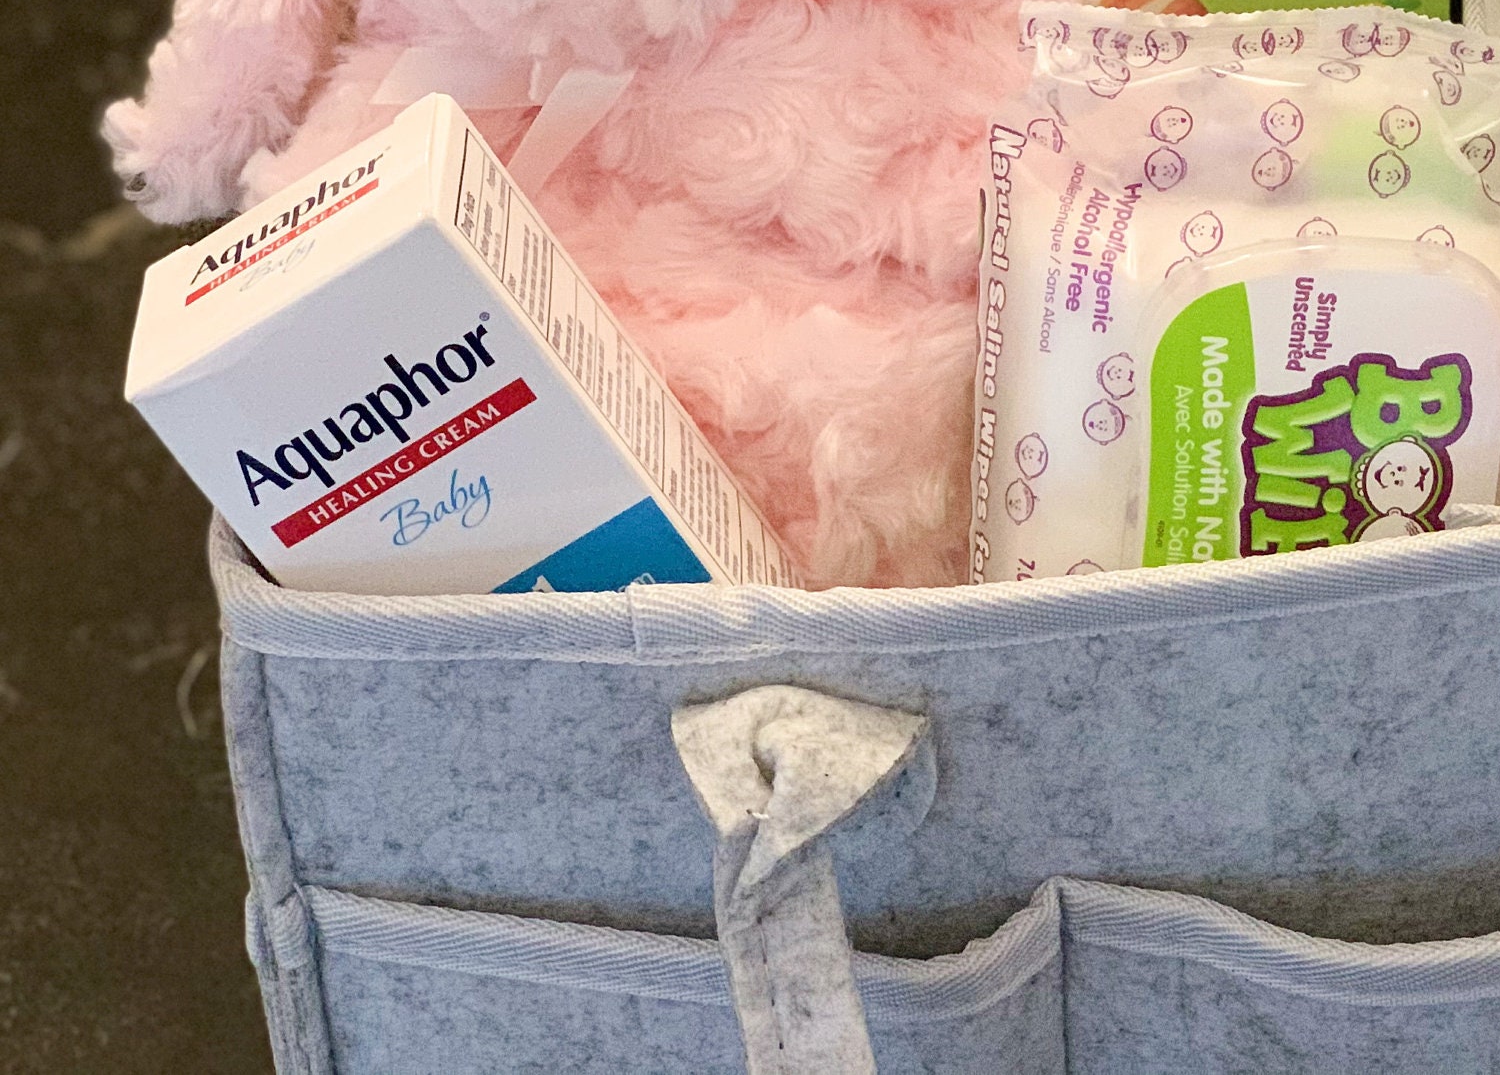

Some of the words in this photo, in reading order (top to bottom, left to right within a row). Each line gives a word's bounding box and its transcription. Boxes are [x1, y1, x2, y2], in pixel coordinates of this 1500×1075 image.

[190, 152, 385, 286] Aquaphor
[208, 234, 290, 290] HEALING
[294, 193, 359, 236] CREAM
[988, 123, 1027, 272] Natural
[1049, 159, 1086, 253] oallergénique
[1072, 187, 1111, 258] Alcohol
[1043, 266, 1061, 304] Sans
[1065, 261, 1089, 313] Free
[1091, 182, 1143, 334] Hypoallergenic
[983, 276, 1006, 400] Saline
[1039, 307, 1056, 354] Alcool
[1285, 276, 1315, 372] Unscented
[1308, 292, 1338, 361] Simply
[235, 324, 497, 507] Aquaphor
[1174, 384, 1194, 433] Avec
[1200, 335, 1232, 430] Made
[306, 454, 415, 525] HEALING
[418, 402, 501, 459] CREAM
[378, 468, 494, 546] Baby
[976, 407, 997, 523] Wipes
[1170, 438, 1195, 521] Solution
[1198, 438, 1230, 506] with
